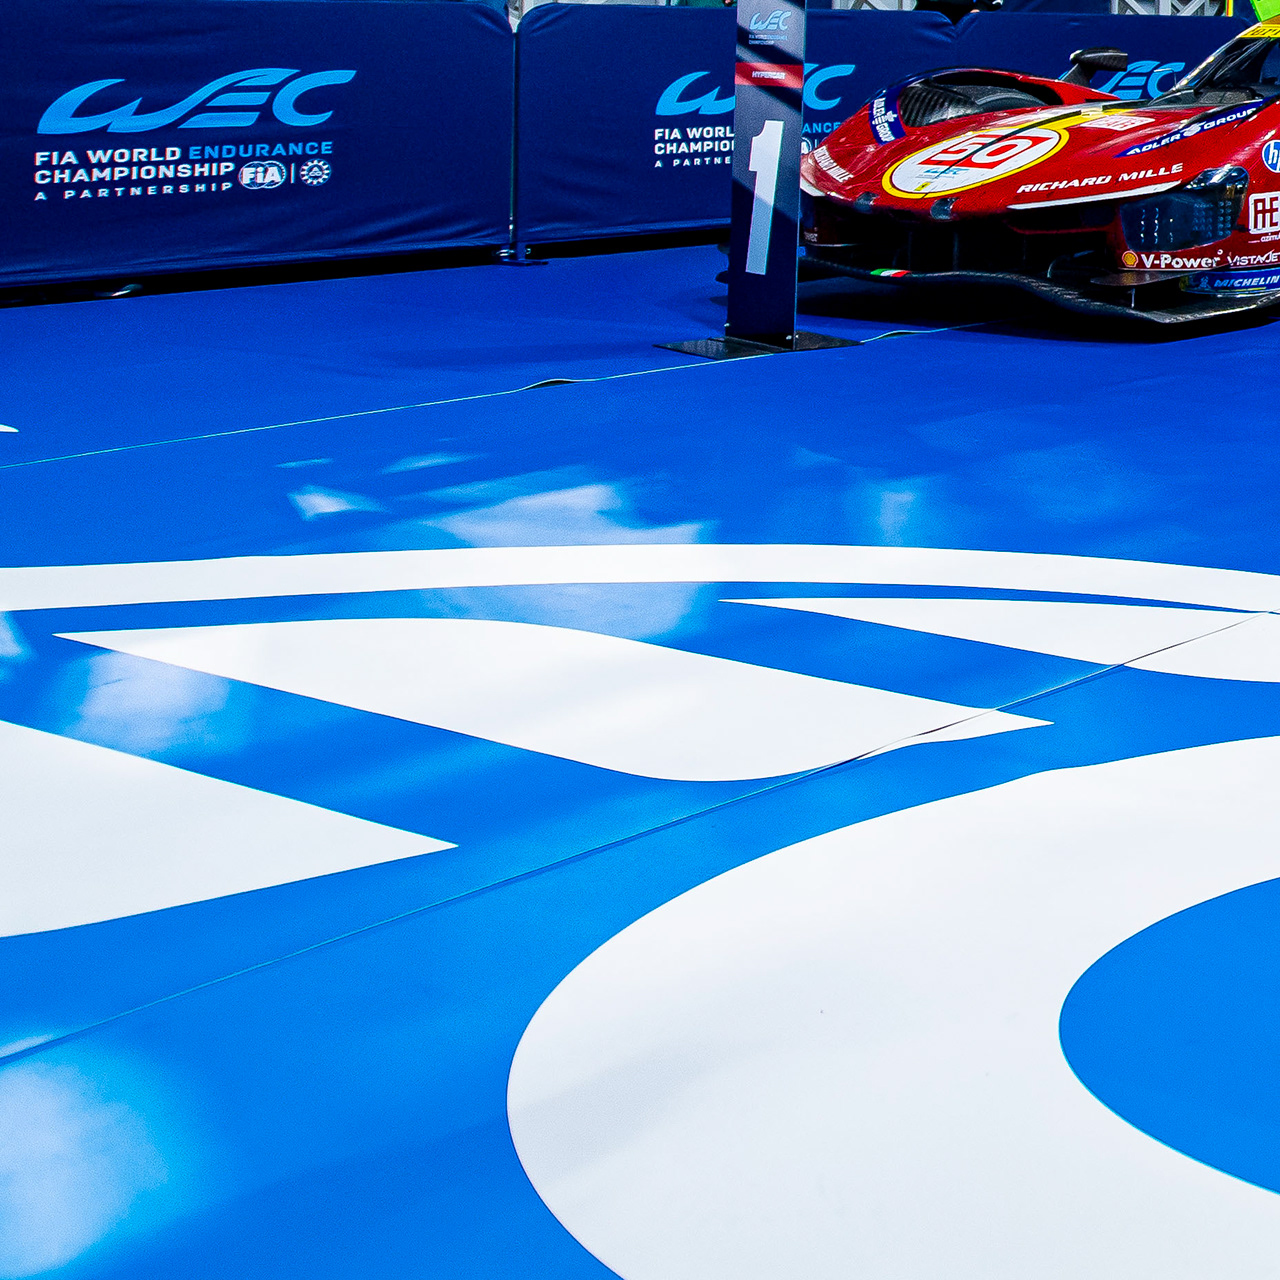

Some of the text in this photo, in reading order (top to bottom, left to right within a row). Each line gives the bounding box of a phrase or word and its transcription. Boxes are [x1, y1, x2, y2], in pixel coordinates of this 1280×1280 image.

[749, 9, 792, 31] WEC
[37, 68, 357, 134] WEC
[654, 125, 735, 140] FIA WORL
[34, 141, 333, 166] FIA WORLD ENDURANCE
[654, 141, 735, 155] CHAMPIO
[931, 134, 1034, 164] 50
[1126, 133, 1181, 156] ADLER
[35, 162, 236, 184] CHAMPIONSHIP
[654, 157, 732, 168] A PARTNE
[1016, 162, 1184, 194] RICHARD MILLE
[34, 182, 233, 201] A PARTNERSHIP
[745, 120, 784, 275] 1
[1141, 253, 1219, 269] V-Power
[1214, 275, 1280, 287] MICHELIN
